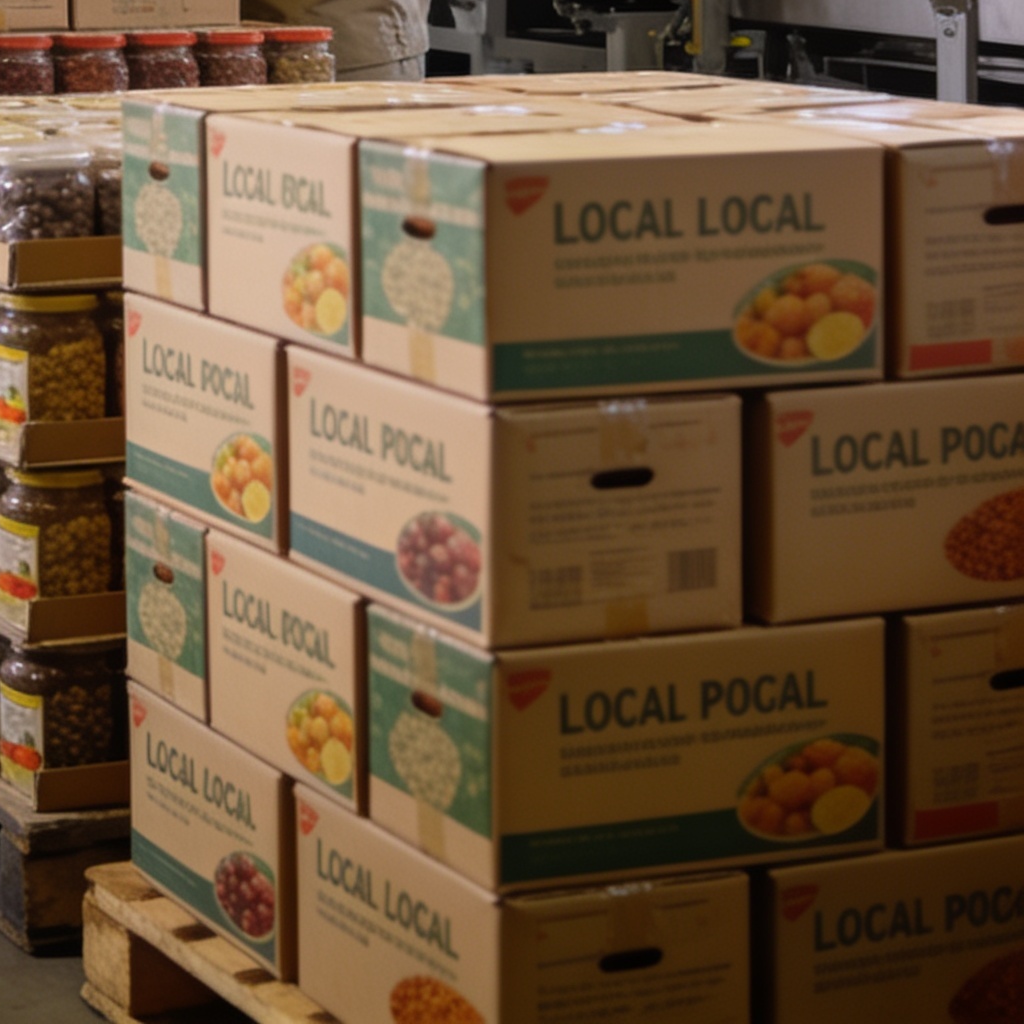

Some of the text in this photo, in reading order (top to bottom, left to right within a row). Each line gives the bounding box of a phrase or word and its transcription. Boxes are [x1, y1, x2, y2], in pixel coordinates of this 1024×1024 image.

[554, 192, 826, 245] LOCAL LOCAL
[142, 338, 195, 388] LOCAL
[310, 397, 374, 456] LOCAL
[381, 421, 453, 483] POCAL
[811, 428, 929, 477] LOCAL
[222, 579, 277, 640] LOCAL
[559, 669, 829, 735] LOCAL POCAL
[146, 731, 198, 794] LOCAL
[203, 766, 256, 831] LOCAL
[317, 837, 378, 911] LOCAL
[384, 879, 460, 961] LOCAL
[814, 897, 933, 952] LOCAL
